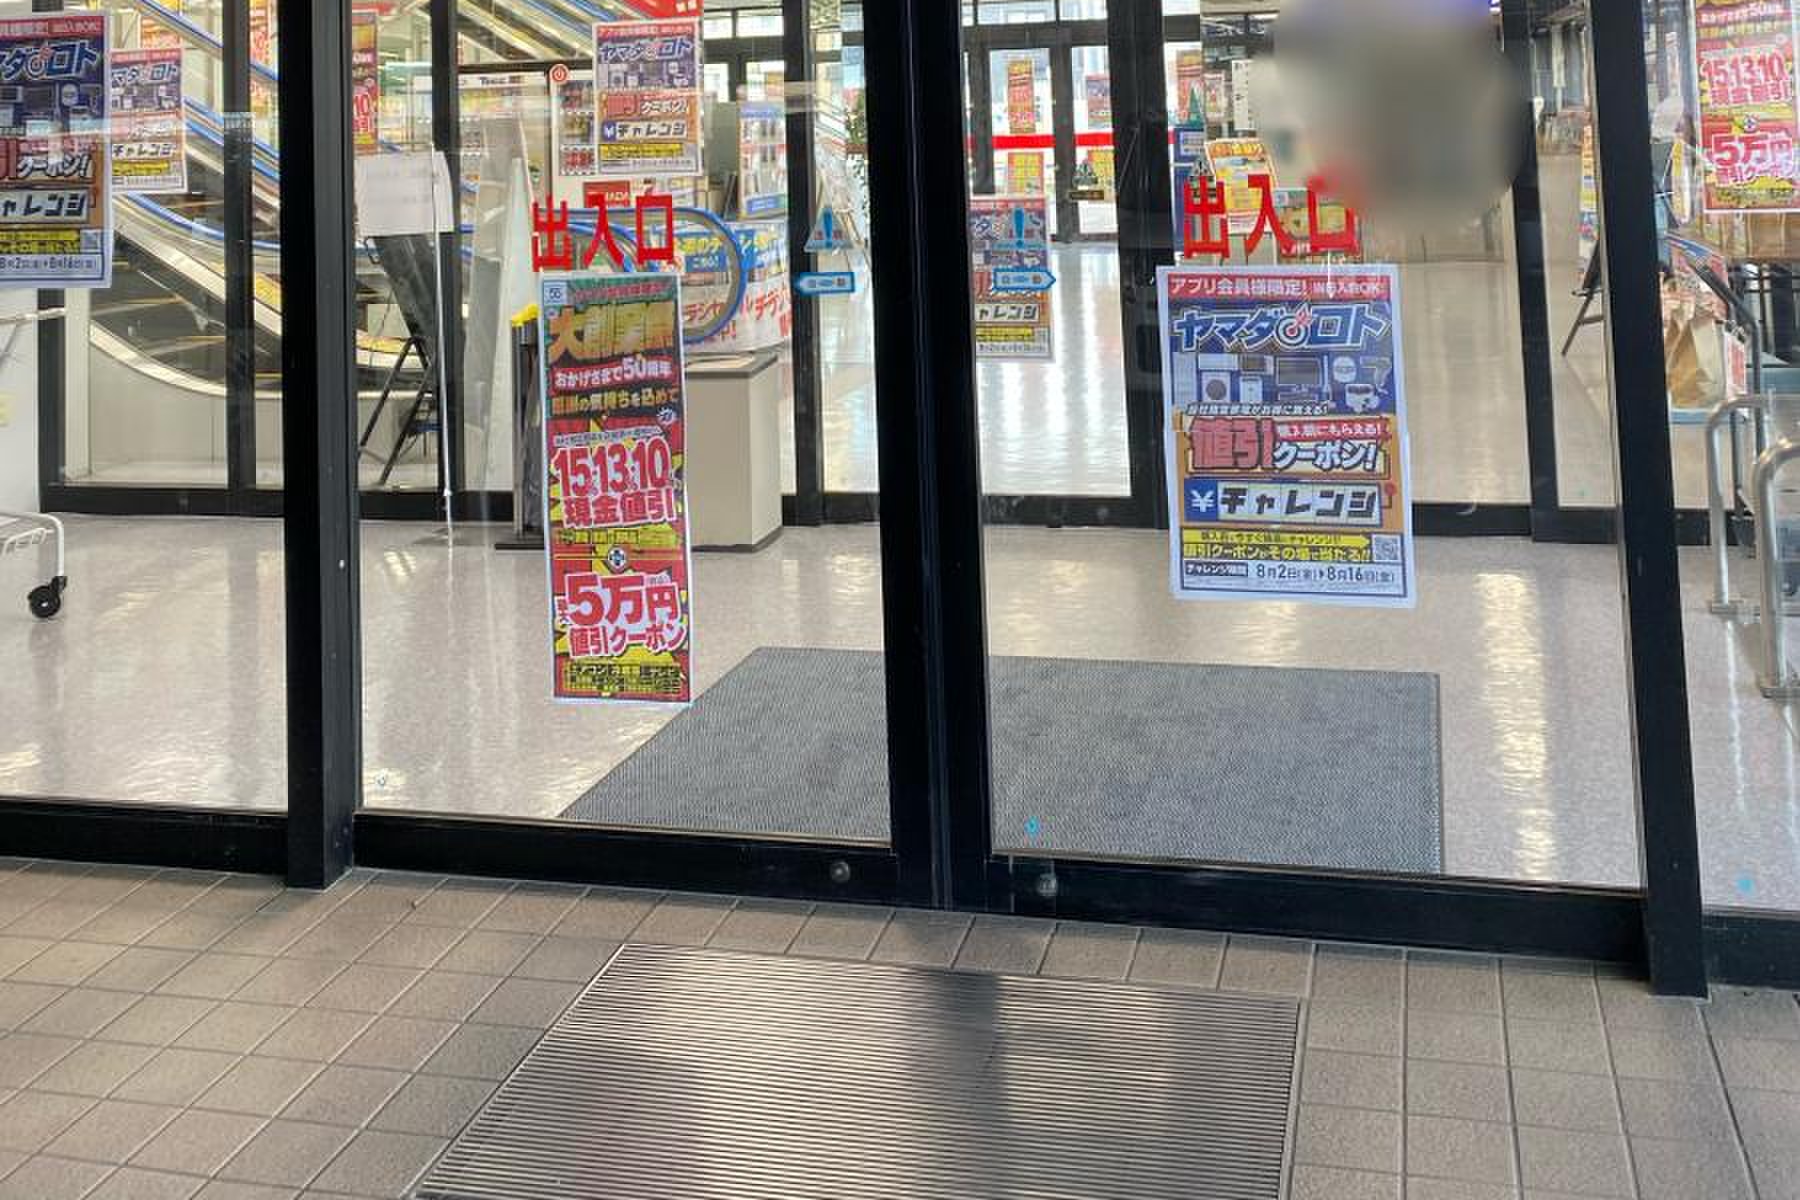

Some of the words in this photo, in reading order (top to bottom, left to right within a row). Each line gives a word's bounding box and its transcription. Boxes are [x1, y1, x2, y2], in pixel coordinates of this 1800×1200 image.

[532, 194, 674, 272] 出入口
[1183, 173, 1361, 259] 出入口
[565, 572, 681, 626] 5万円
[568, 623, 687, 658] 値引クーポン
